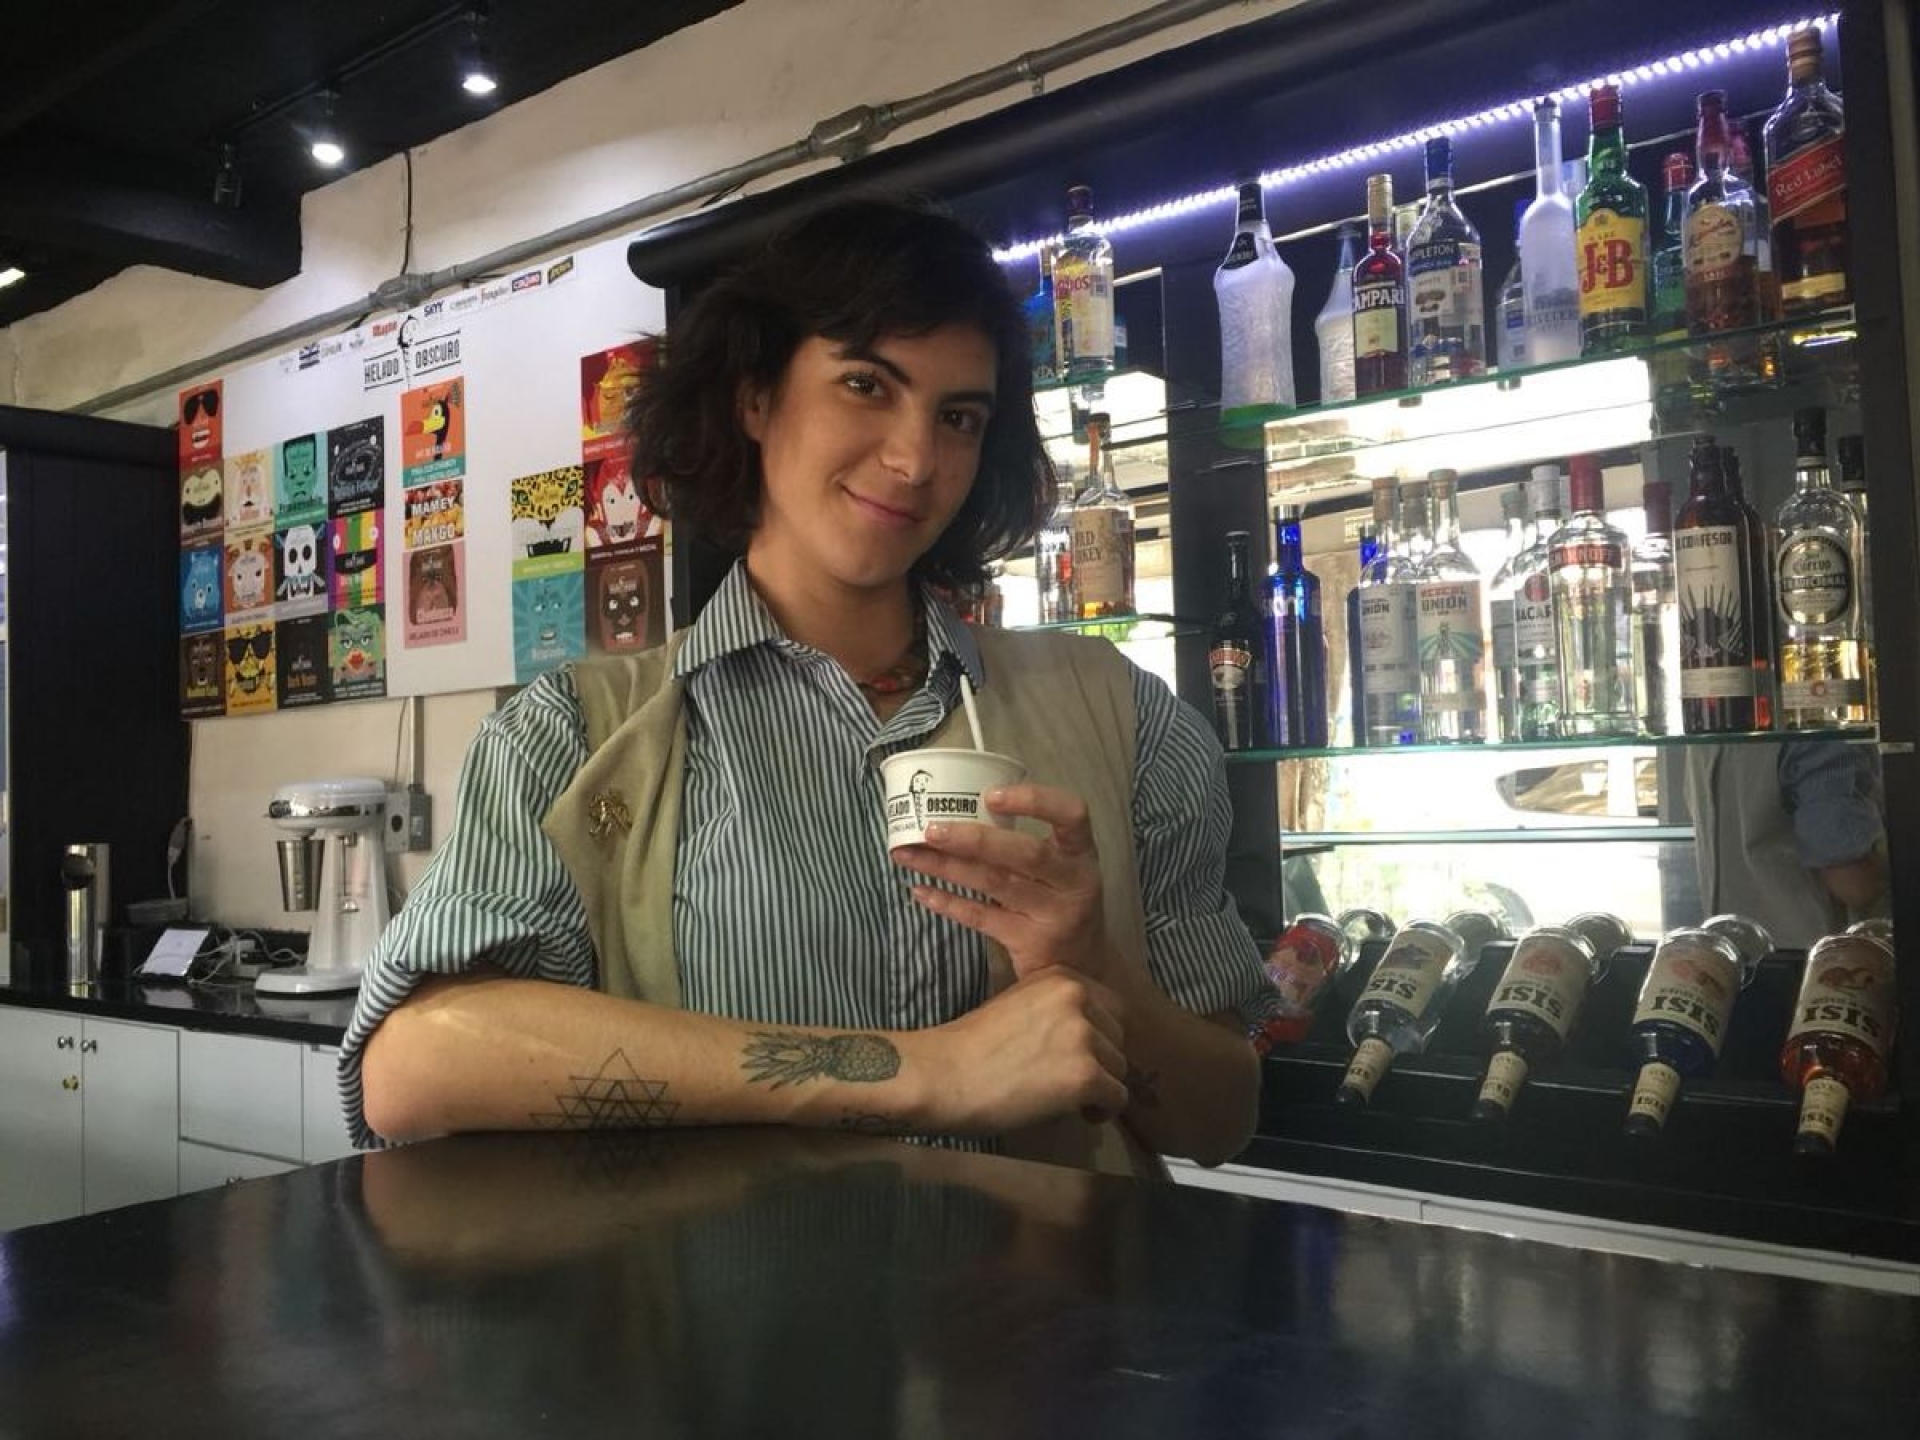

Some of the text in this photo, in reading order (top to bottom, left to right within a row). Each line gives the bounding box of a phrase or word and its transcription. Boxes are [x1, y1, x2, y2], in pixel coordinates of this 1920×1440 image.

[1774, 173, 1803, 197] Red
[1354, 285, 1405, 310] AMPARI
[415, 338, 460, 368] OBSCURO
[411, 497, 454, 515] MAMEY
[412, 523, 456, 545] MANGO
[1421, 595, 1467, 611] UNION
[927, 797, 978, 814] OBSCURO
[1368, 978, 1417, 1000] SIS
[1499, 986, 1563, 1020] ISIS
[1651, 995, 1719, 1038] ISIS
[1803, 1004, 1881, 1038] ISIS
